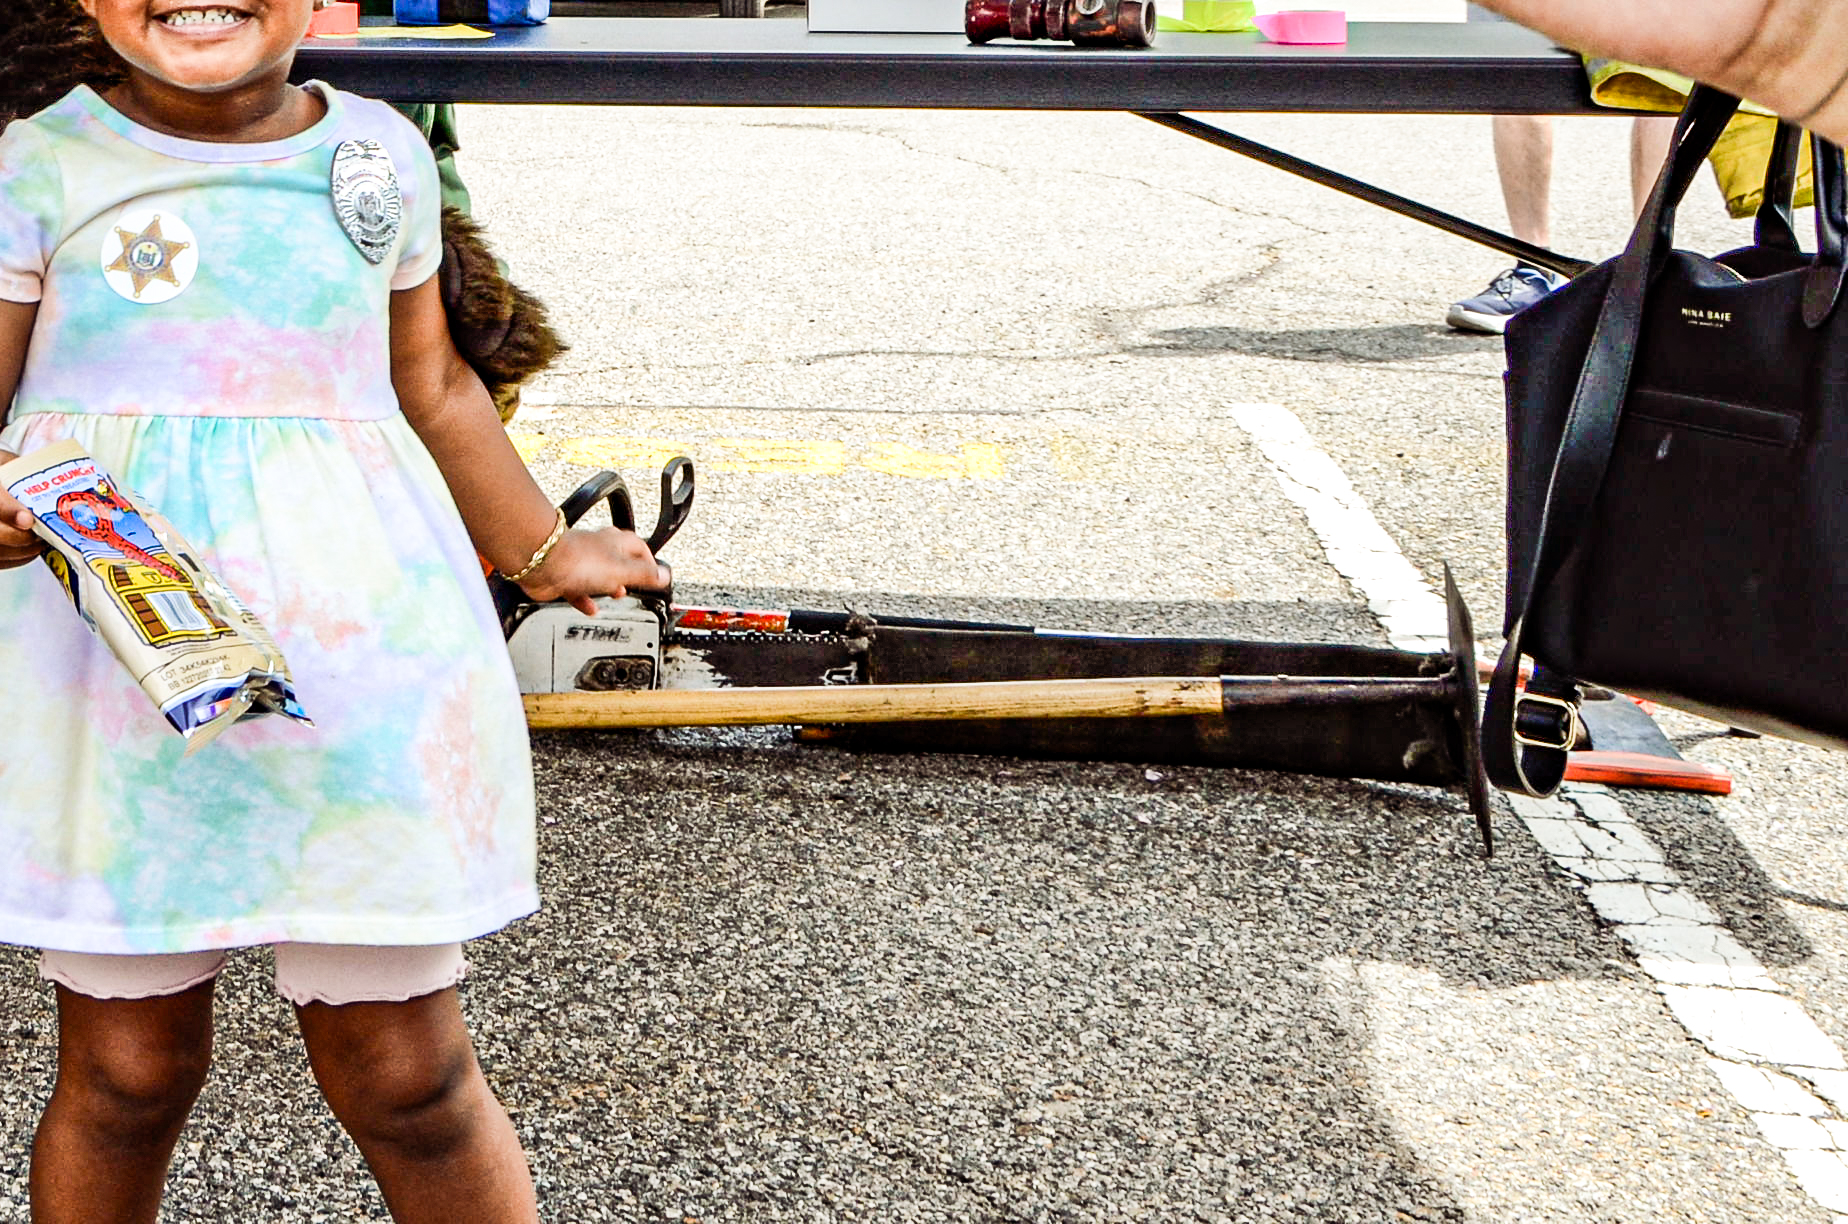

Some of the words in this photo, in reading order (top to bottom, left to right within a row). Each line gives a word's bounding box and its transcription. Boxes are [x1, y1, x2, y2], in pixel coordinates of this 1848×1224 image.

[23, 480, 50, 496] HELP
[564, 624, 631, 643] STIHL
[161, 668, 177, 682] LOT
